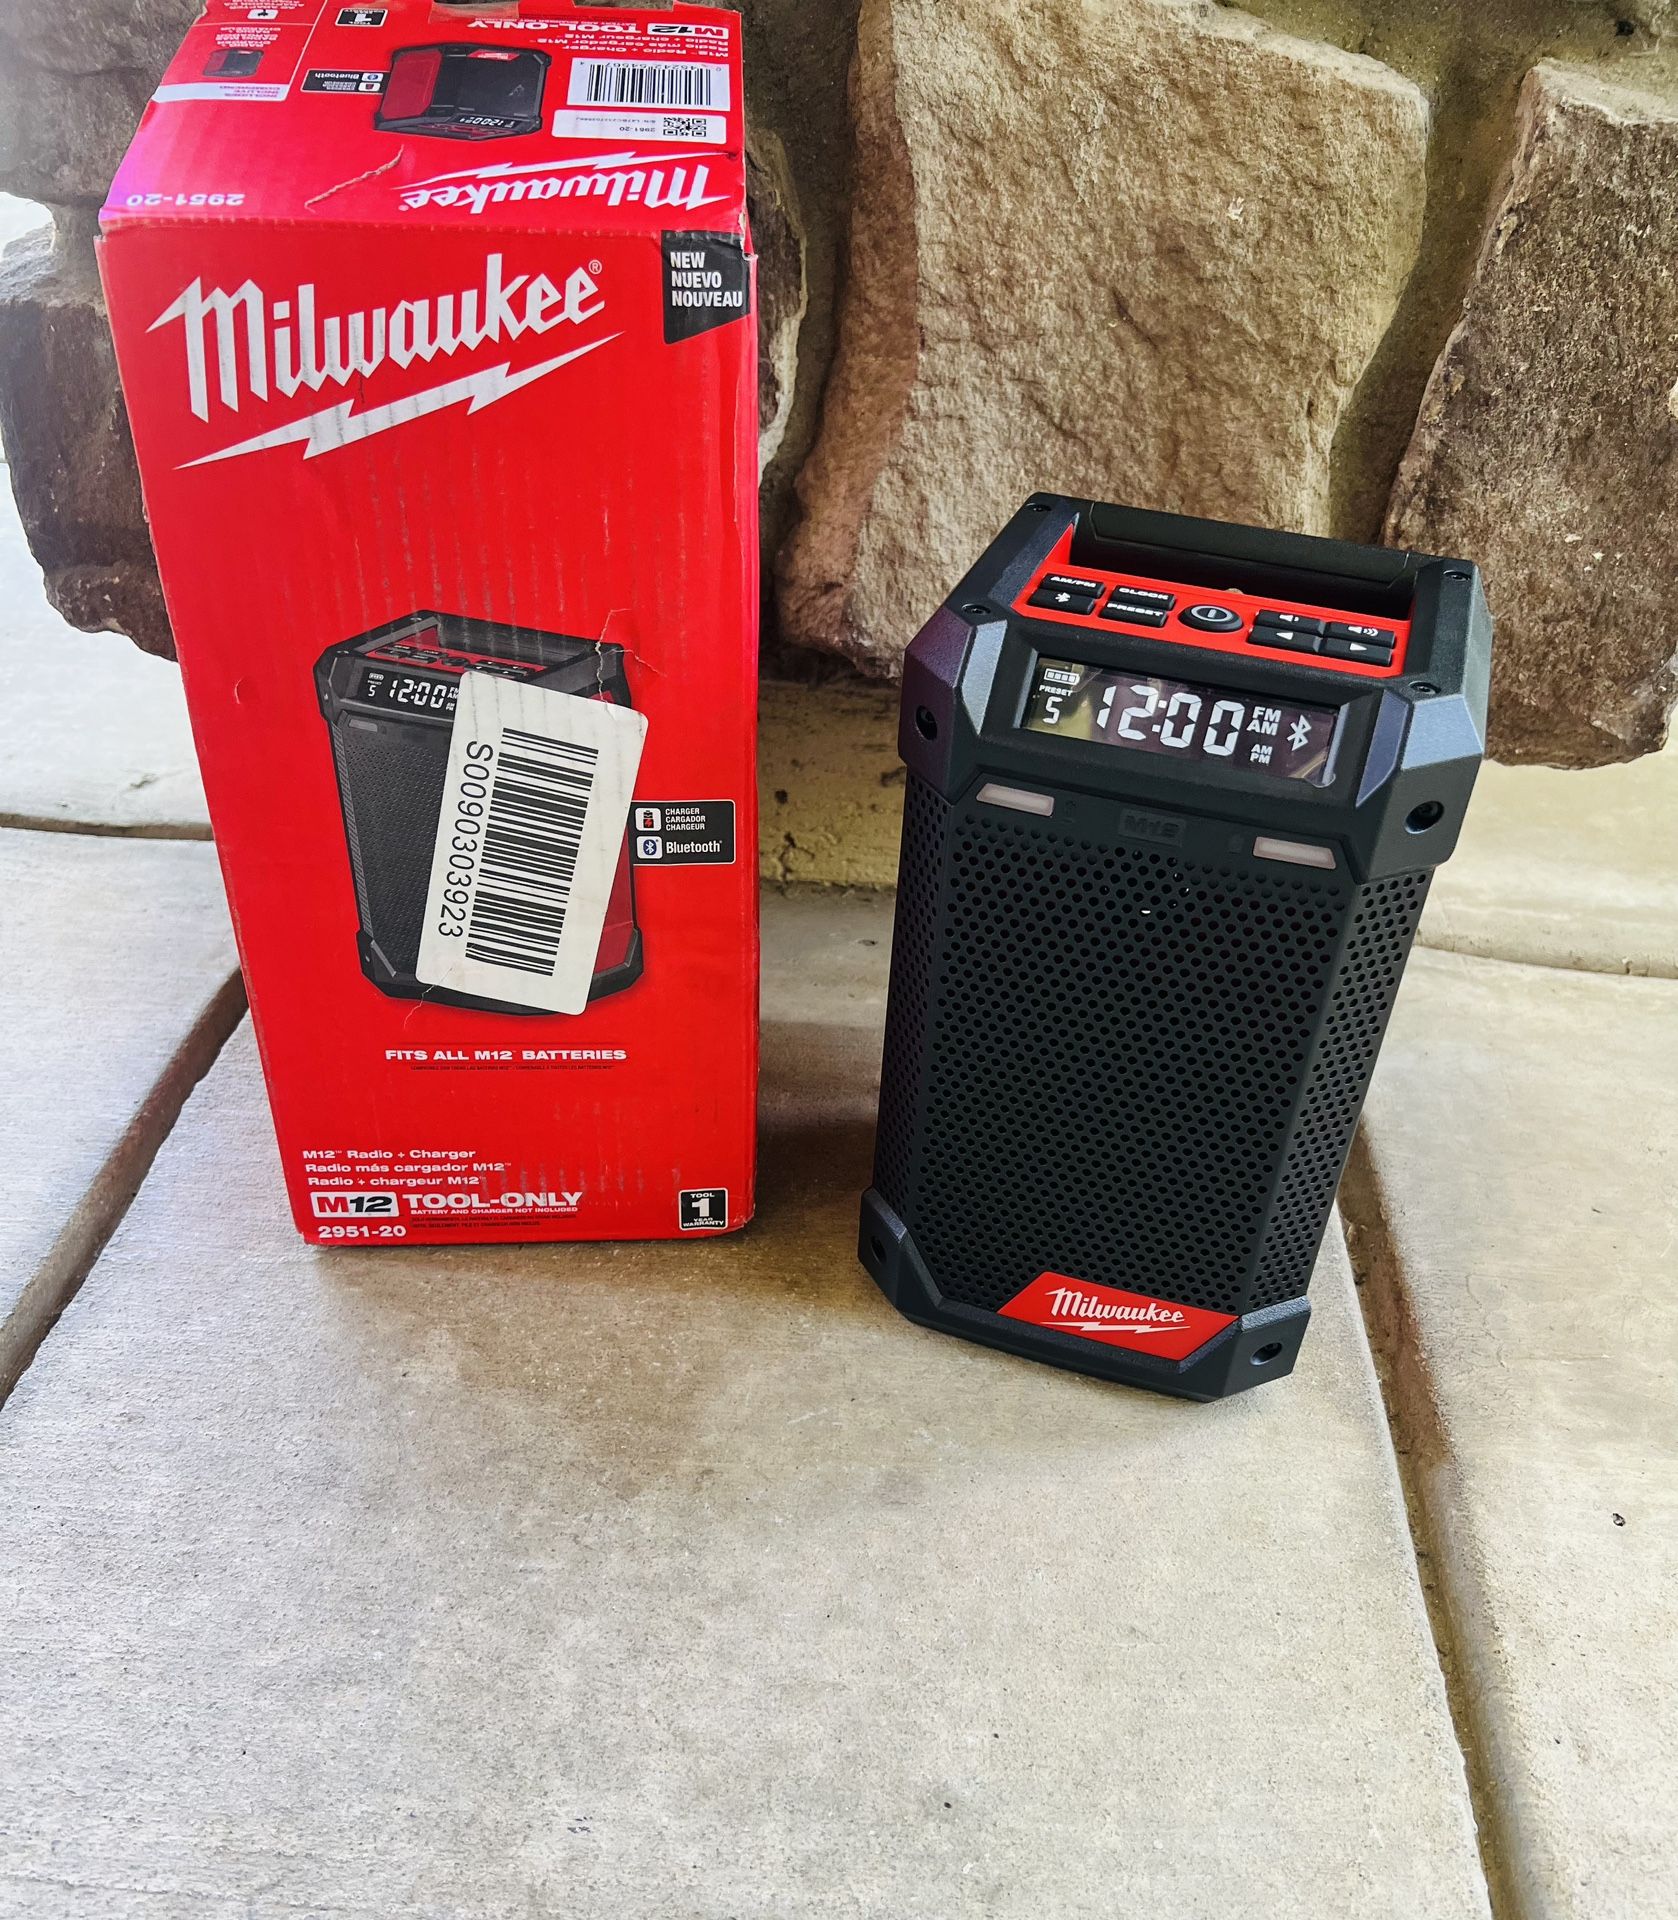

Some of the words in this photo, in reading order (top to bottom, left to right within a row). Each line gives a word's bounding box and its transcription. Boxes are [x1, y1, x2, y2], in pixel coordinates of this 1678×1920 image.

[467, 21, 641, 34] TOOL-ONLY
[651, 25, 724, 36] M12
[400, 164, 731, 214] Milwaukee
[126, 193, 246, 206] 2951-20
[670, 252, 706, 269] NEW
[671, 271, 722, 288] NUEVO
[671, 290, 743, 307] NOUVEAU
[144, 252, 606, 424] Milwaukee
[1051, 576, 1096, 588] AM/FM
[1119, 587, 1169, 600] CLOCK
[1107, 603, 1164, 616] PRESET
[389, 679, 447, 709] 12:00
[1039, 685, 1074, 697] PRESET
[1096, 684, 1246, 757] 12:00
[1252, 706, 1282, 723] FM
[1246, 719, 1279, 736] AM
[1250, 744, 1273, 755] AM
[1249, 753, 1271, 765] PM
[665, 808, 700, 816] CHARGER
[665, 816, 706, 824] CARGADOR
[665, 823, 705, 831] CHARGEUR
[437, 740, 495, 939] S0090303923
[666, 841, 721, 854] Bluetooth
[385, 1049, 428, 1060] FITS
[433, 1049, 470, 1060] ALL
[522, 1049, 627, 1060] BATTERIES
[347, 1149, 393, 1159] Radio
[409, 1149, 476, 1160] Charger
[305, 1163, 352, 1173] Radio
[355, 1163, 390, 1172] más
[393, 1162, 468, 1174] cargador
[307, 1177, 354, 1186] Radio
[369, 1177, 443, 1187] chargeur
[315, 1196, 393, 1213] M12
[401, 1191, 583, 1209] TOOL-ONLY
[692, 1198, 710, 1217] 1
[683, 1220, 724, 1228] WARRANTY
[318, 1225, 407, 1239] 2951-20
[1044, 1287, 1186, 1323] Milwaukee
